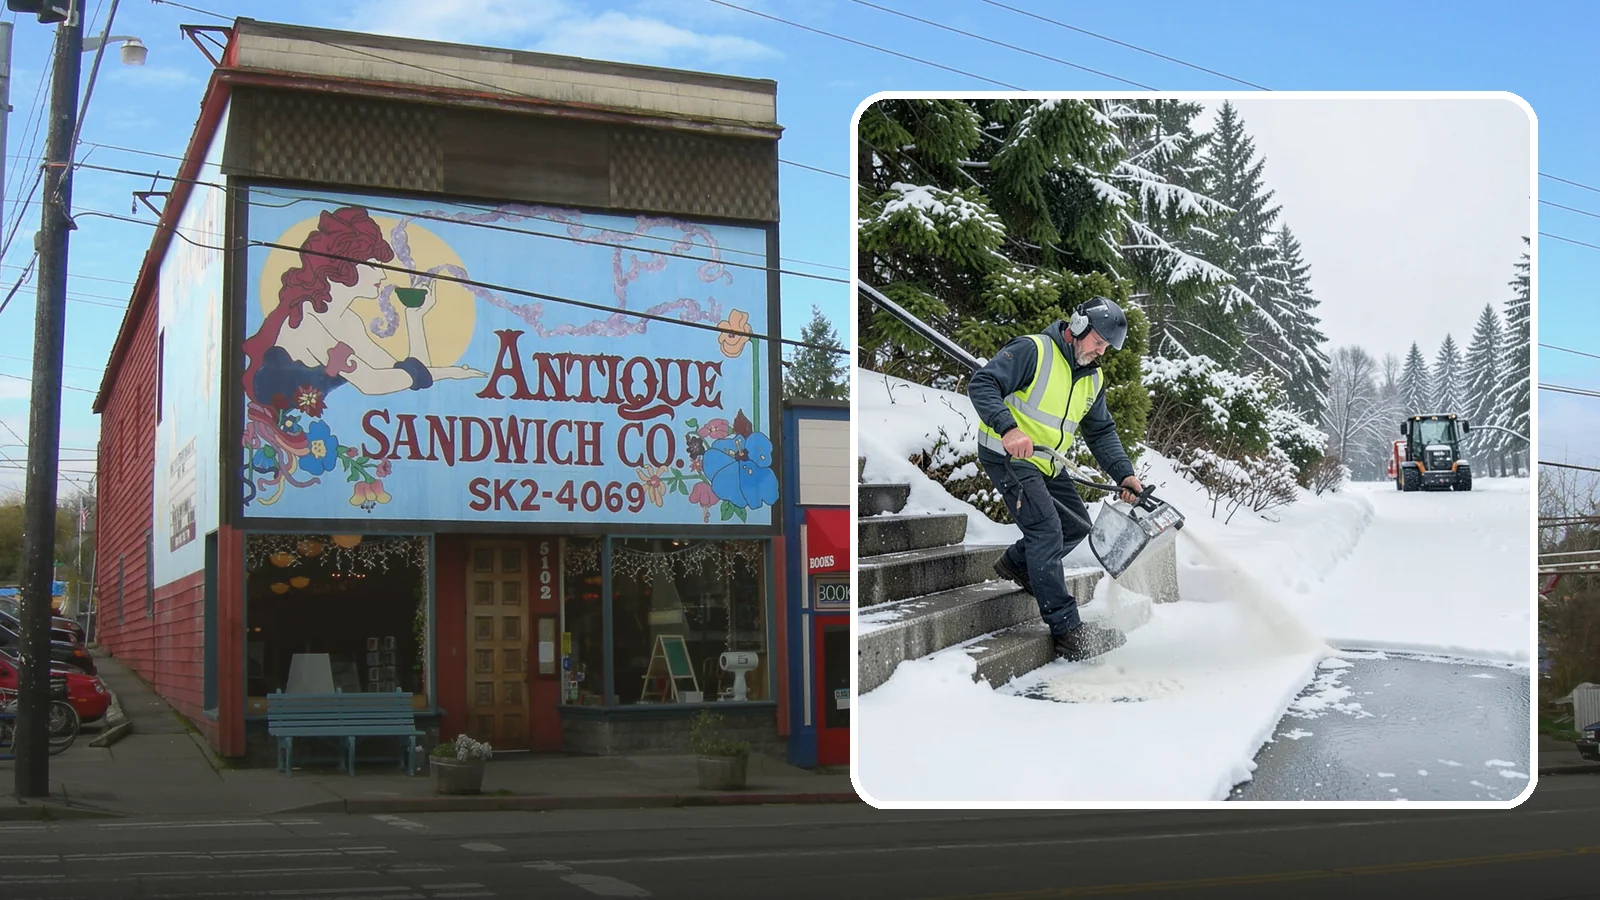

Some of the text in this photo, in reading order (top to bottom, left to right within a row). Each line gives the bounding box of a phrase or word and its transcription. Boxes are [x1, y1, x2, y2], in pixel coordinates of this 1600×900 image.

[475, 329, 723, 421] ANTIQUE
[361, 408, 685, 468] SANDWICH CO.
[468, 477, 646, 513] SK2-4069
[539, 542, 552, 599] 5102
[809, 555, 835, 569] BOOKS
